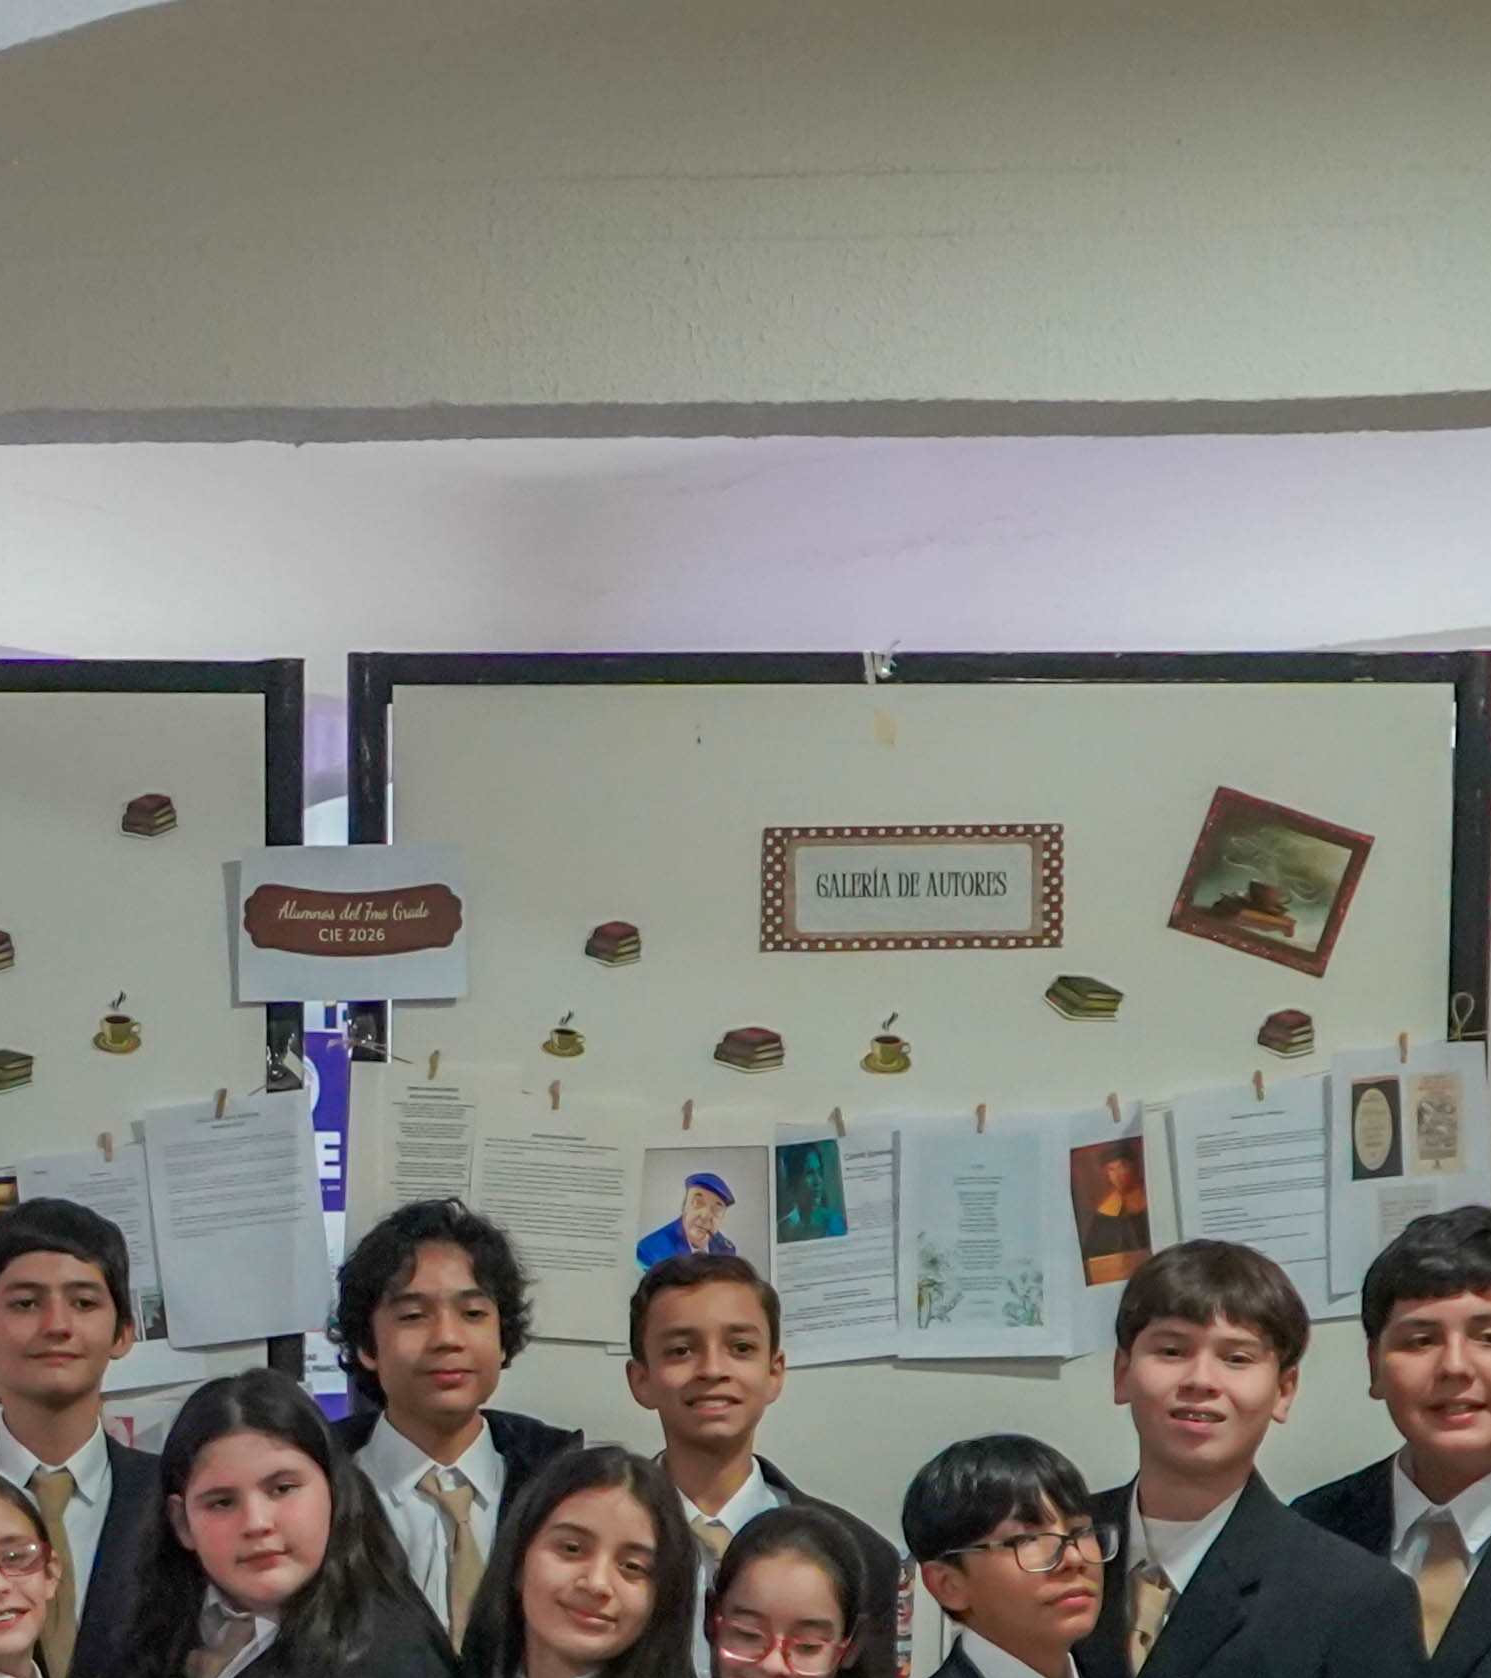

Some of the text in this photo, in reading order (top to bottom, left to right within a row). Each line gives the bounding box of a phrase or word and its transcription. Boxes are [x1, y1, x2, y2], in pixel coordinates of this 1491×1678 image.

[816, 866, 1008, 898] GALERÍA DE AUTORES
[278, 900, 336, 921] Alumnos
[339, 900, 361, 921] del
[318, 928, 386, 942] CIE 2026
